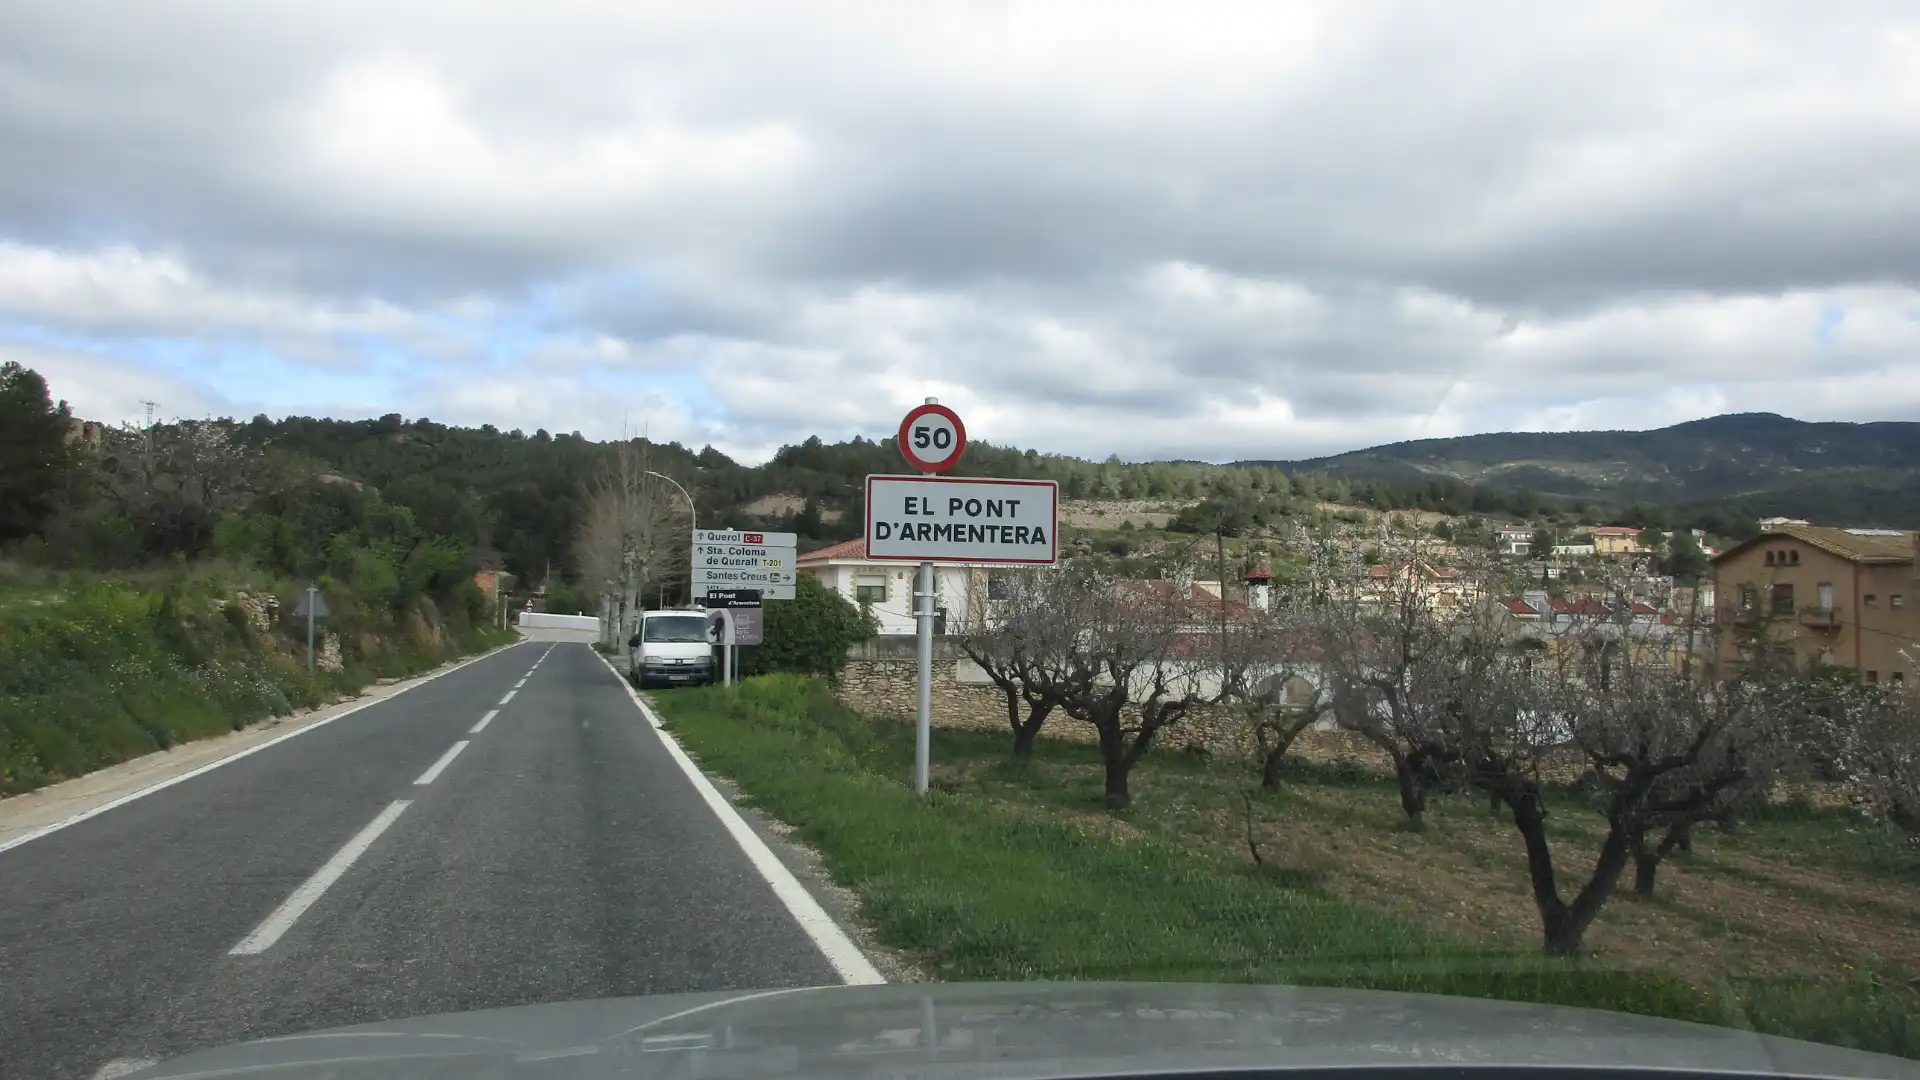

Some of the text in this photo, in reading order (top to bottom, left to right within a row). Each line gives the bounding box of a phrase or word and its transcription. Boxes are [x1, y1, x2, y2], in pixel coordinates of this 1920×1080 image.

[914, 426, 951, 450] 50
[904, 496, 1021, 518] EL PONT
[707, 532, 762, 543] Querol C-37
[875, 521, 1047, 545] D'ARMENTERA
[706, 546, 766, 556] Sta. Coloma
[706, 557, 782, 567] de Queralt T-201
[706, 571, 768, 581] Santes Creus
